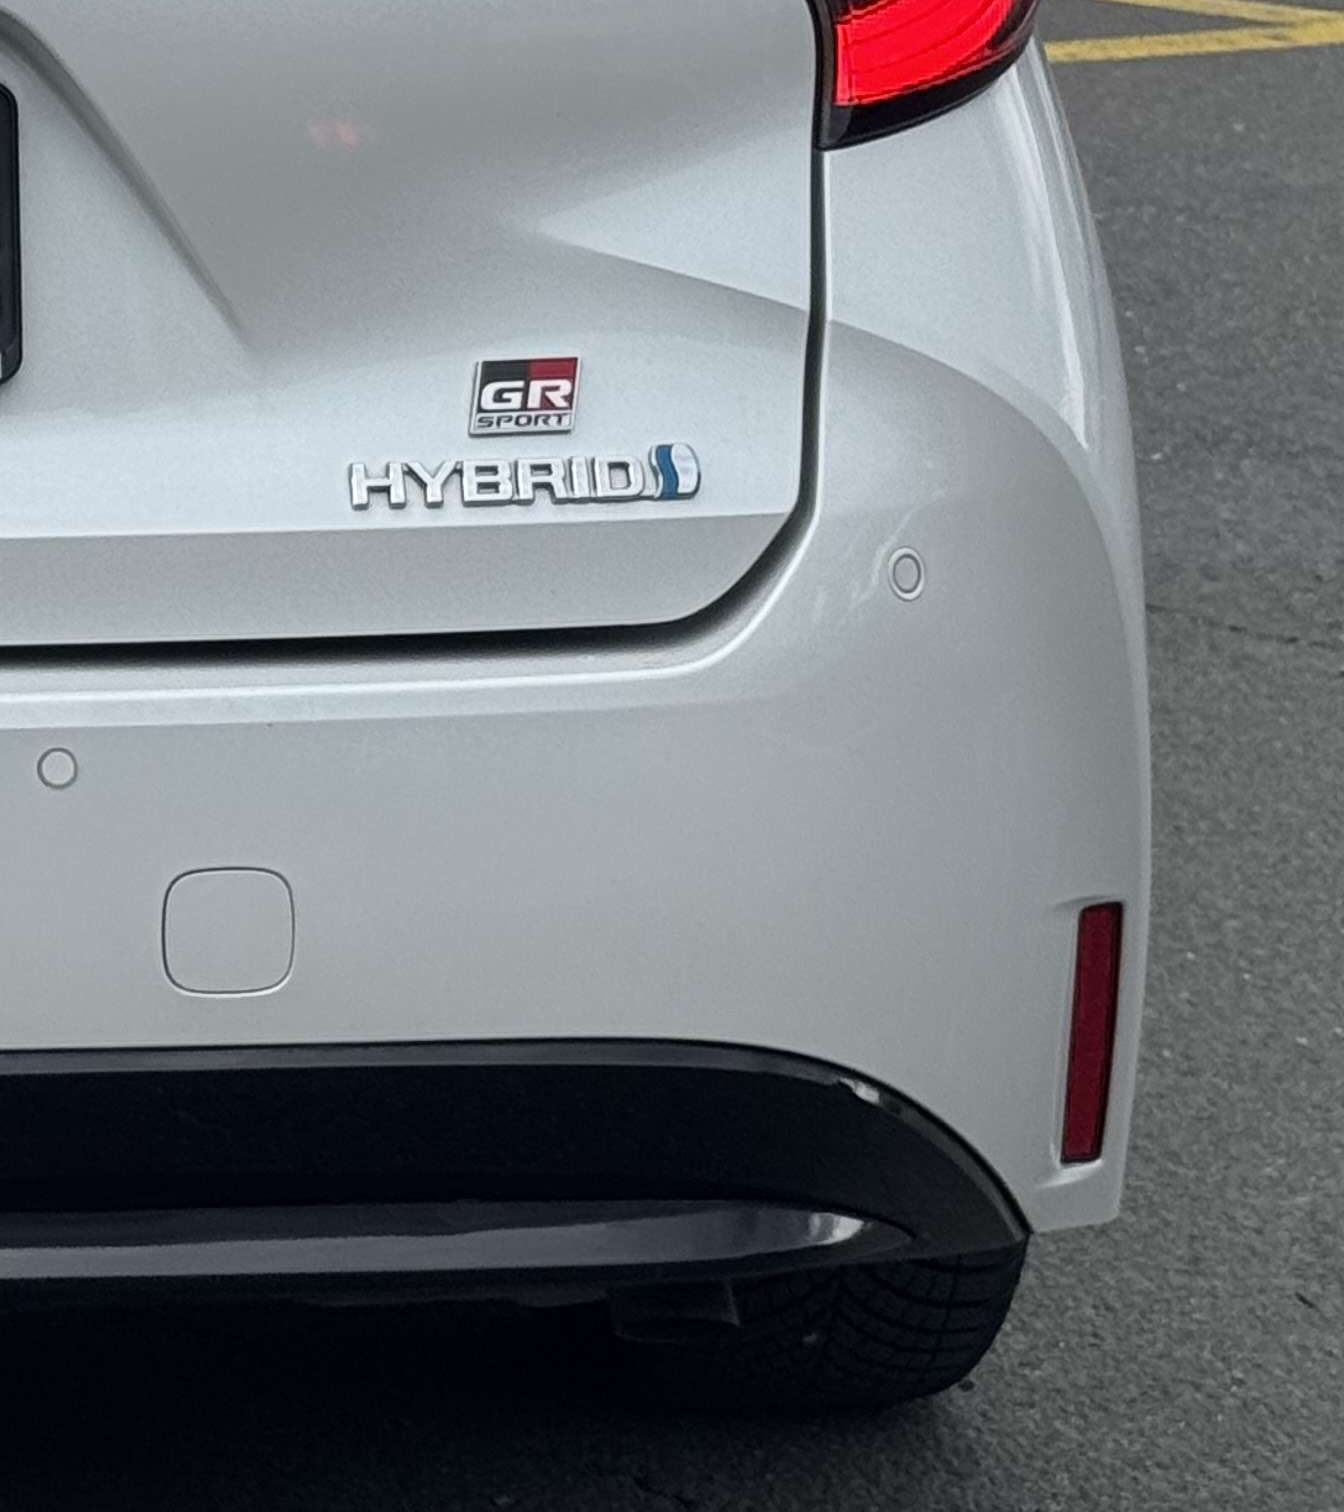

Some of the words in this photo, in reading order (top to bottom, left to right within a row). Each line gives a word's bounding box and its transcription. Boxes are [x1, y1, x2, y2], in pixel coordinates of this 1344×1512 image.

[480, 379, 573, 410] GR
[476, 412, 569, 430] SPORT
[349, 456, 646, 510] HYBRID
